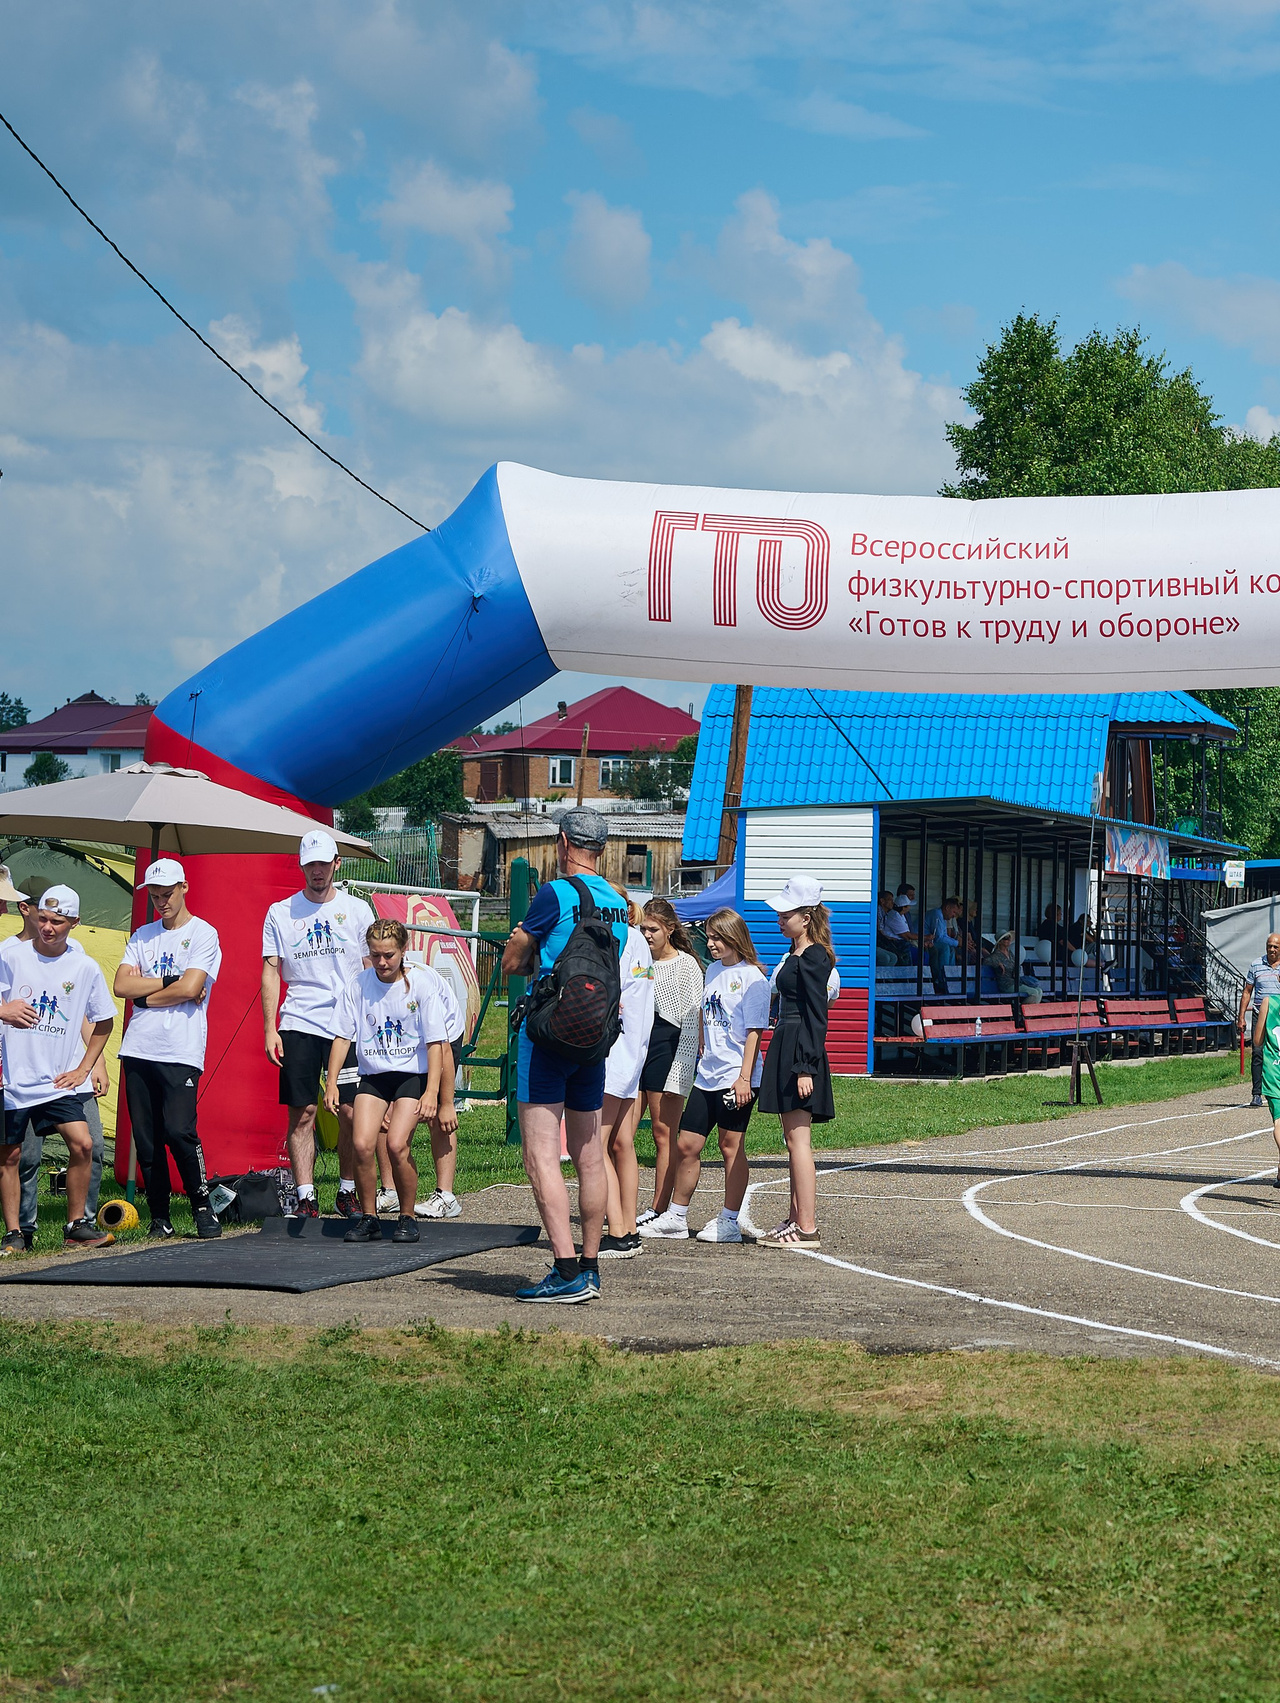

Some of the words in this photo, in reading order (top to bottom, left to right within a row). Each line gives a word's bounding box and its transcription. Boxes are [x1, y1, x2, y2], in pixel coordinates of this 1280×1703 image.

[851, 532, 1069, 560] Всероссийский
[648, 511, 830, 630] ГТО
[847, 569, 1240, 606] физкультурно-спортивный
[849, 611, 947, 639] «Готов
[956, 620, 971, 639] к
[980, 619, 1061, 645] труду
[1071, 620, 1088, 638] и
[1098, 612, 1240, 639] обороне»
[293, 950, 318, 960] ЗЕМЛЯ
[320, 947, 346, 956] СПОРТА
[364, 1048, 388, 1057] ЗЕМЛЯ
[389, 1046, 416, 1056] СПОРТ
